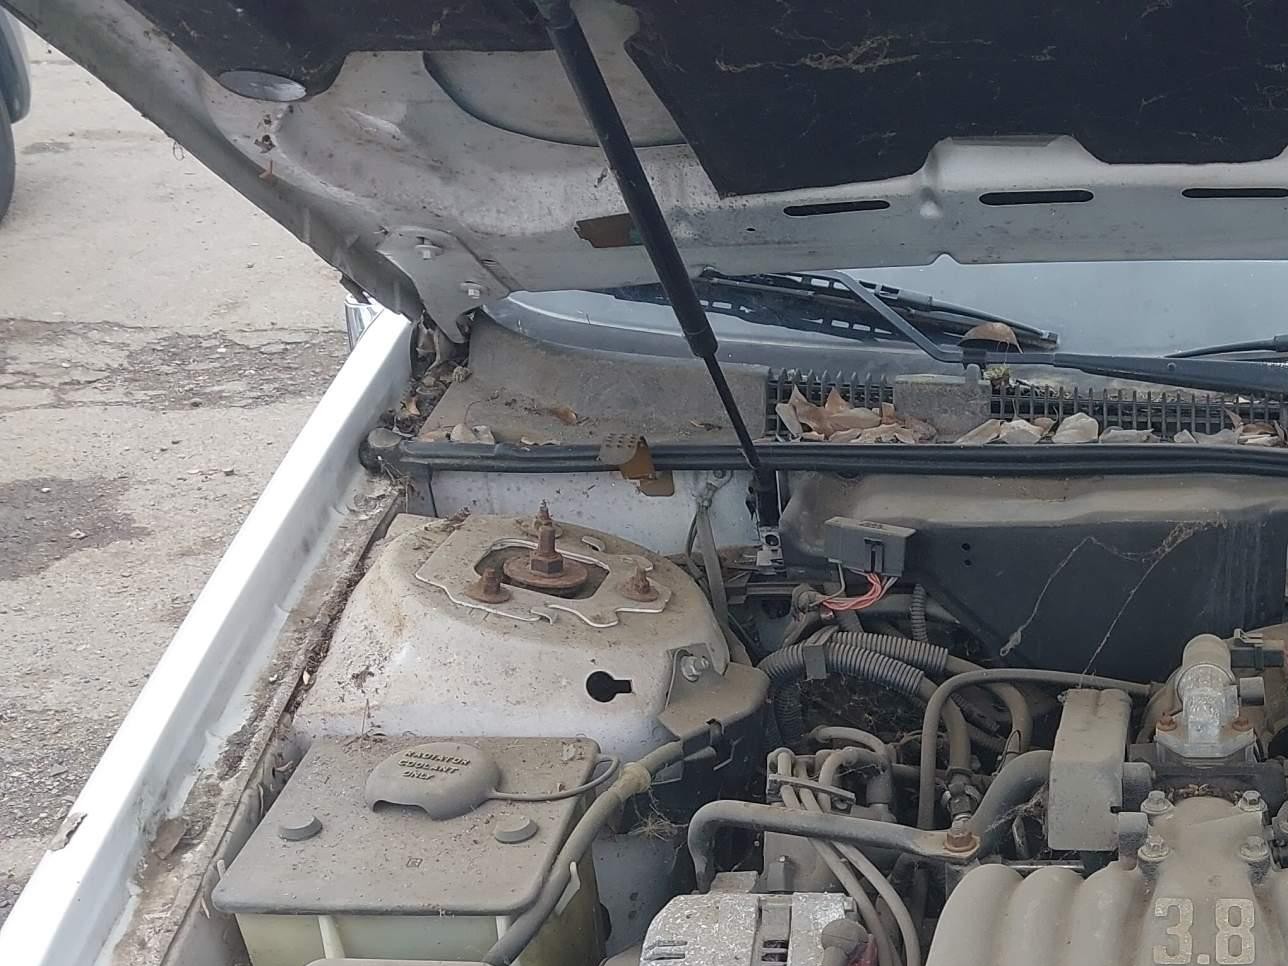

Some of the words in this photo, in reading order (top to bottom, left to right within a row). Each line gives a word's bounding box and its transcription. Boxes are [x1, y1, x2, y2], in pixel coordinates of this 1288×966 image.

[405, 750, 471, 766] RADIATOR
[397, 758, 460, 775] COOLANT
[400, 769, 434, 781] ONLY
[1153, 898, 1255, 966] 3.8
